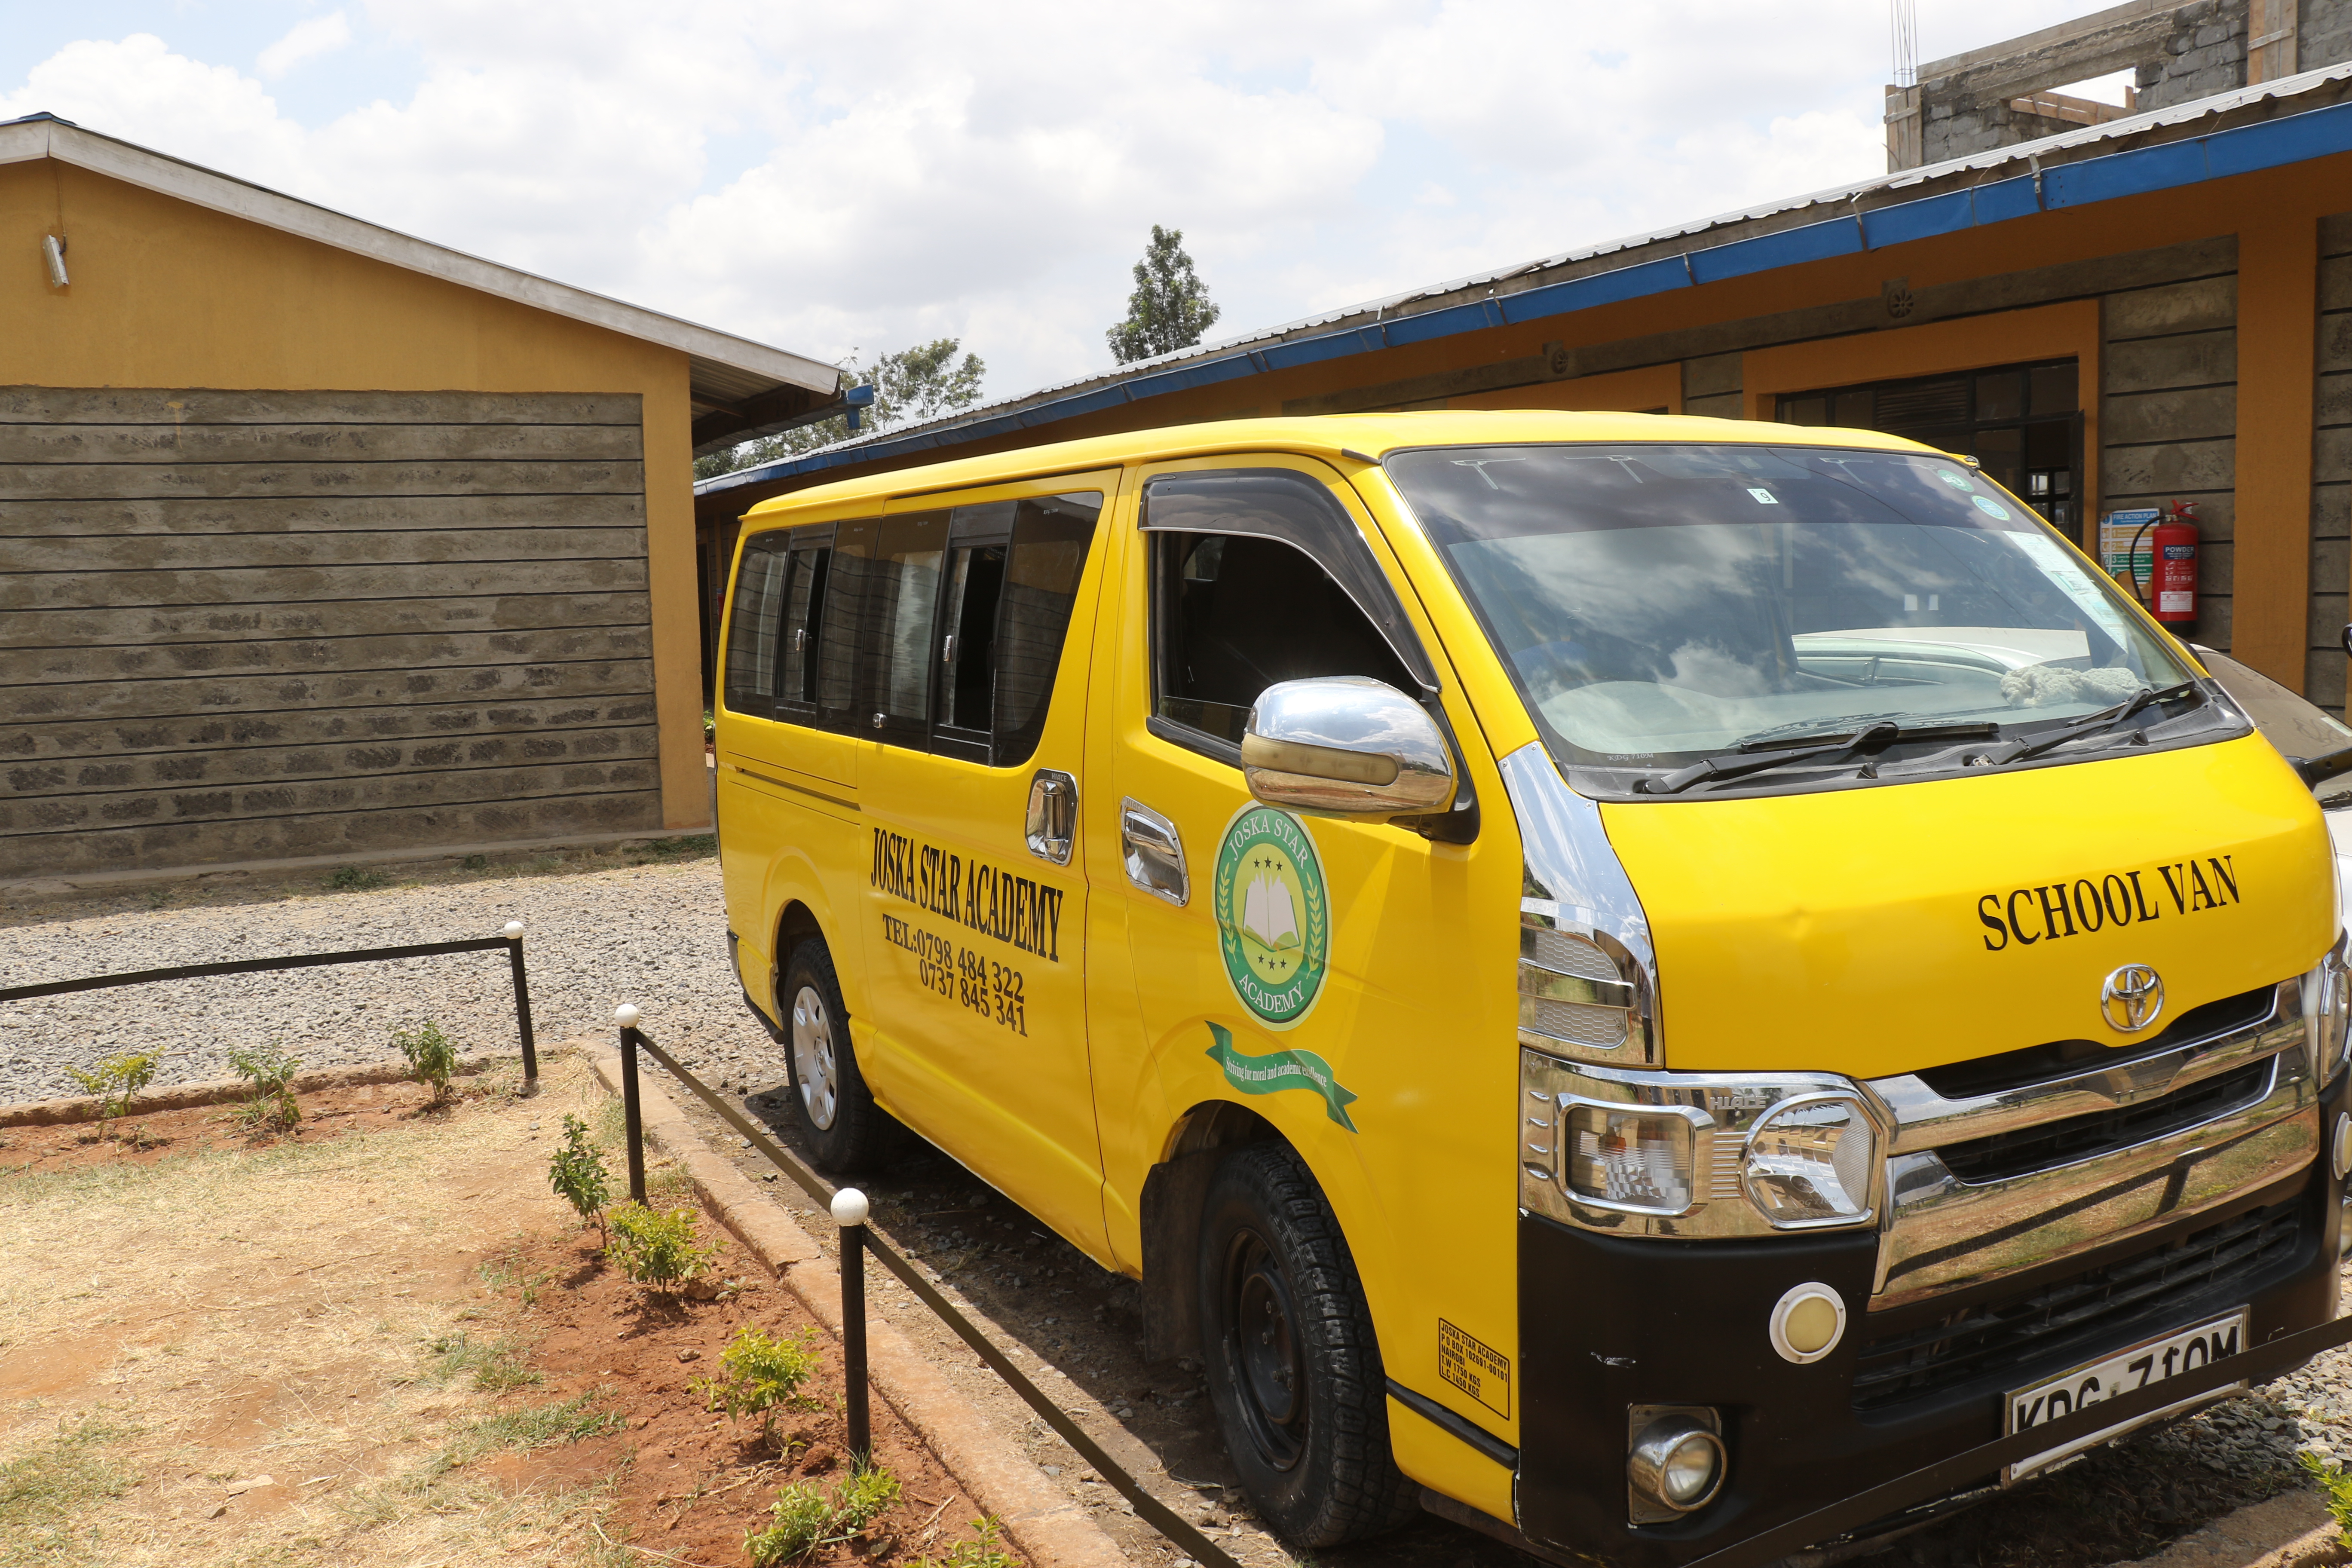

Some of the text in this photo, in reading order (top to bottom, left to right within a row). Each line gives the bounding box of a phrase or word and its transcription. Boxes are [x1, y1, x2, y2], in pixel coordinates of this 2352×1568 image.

[1051, 773, 1067, 782] HIACE
[1229, 815, 1308, 869] JOSKA STAR
[871, 827, 1063, 963] JOSKA STAR ACADEMY
[1978, 855, 2240, 951] SCHOOL VAN
[882, 913, 1024, 1004] TEL:0798 484 322
[919, 959, 1028, 1038] 0737 845 341
[1239, 974, 1304, 1013] ACADEMY
[1226, 1057, 1244, 1081] Striving
[1253, 1066, 1267, 1081] moral
[1267, 1063, 1277, 1080] and
[1277, 1060, 1302, 1077] academic
[1302, 1066, 1327, 1087] excellence
[1710, 1096, 1766, 1110] HIACE
[1441, 1323, 1507, 1370] JOSKA STAR ACADEMY
[1441, 1344, 1465, 1367] NAIROBI
[1441, 1333, 1445, 1342] P
[1452, 1340, 1464, 1354] BOX
[1466, 1349, 1507, 1383] 102691-00101
[1441, 1355, 1481, 1387] T.W 1750 KGS
[1442, 1366, 1480, 1398] L.C 1450 KGS
